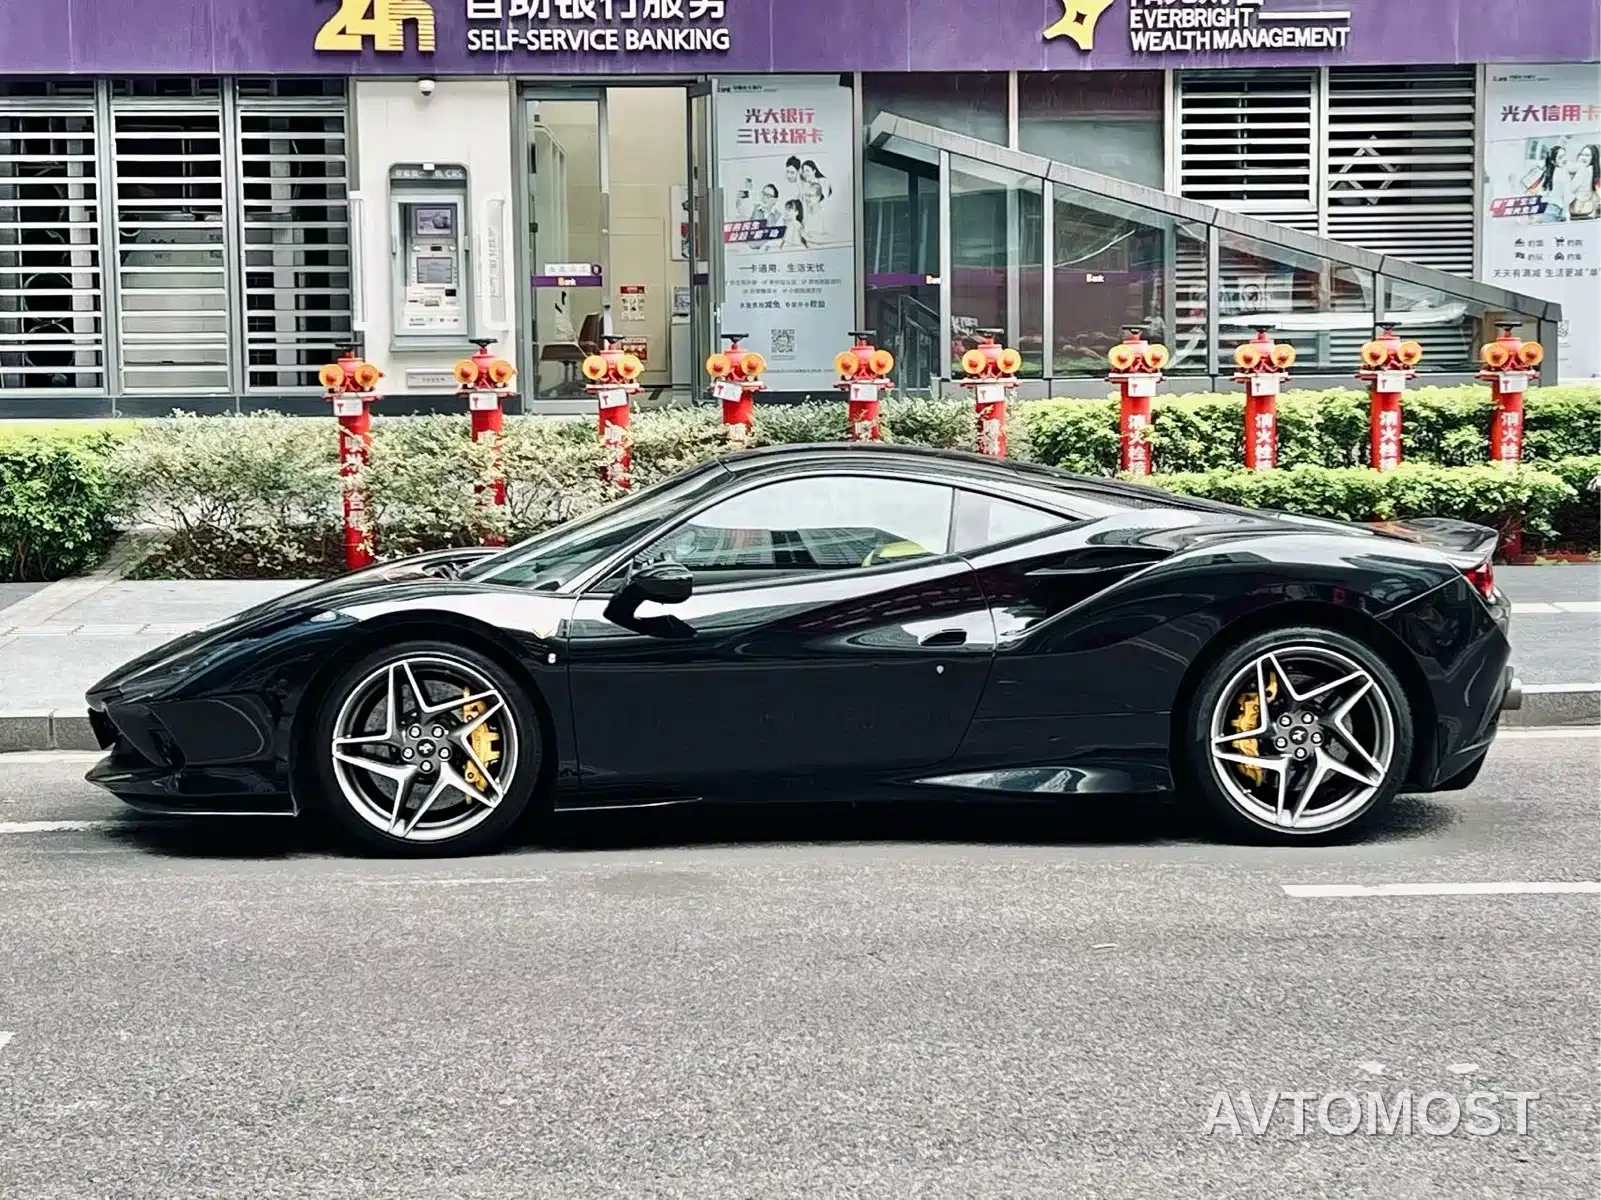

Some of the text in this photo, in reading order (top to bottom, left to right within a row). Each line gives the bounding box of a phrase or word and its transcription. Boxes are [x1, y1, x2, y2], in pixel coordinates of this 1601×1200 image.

[1129, 8, 1254, 28] EVERBRIGHT
[467, 28, 730, 51] SELF-SERVICE BANKING
[1130, 26, 1351, 51] WEALTH MANAGEMENT
[745, 108, 815, 124] 光大银行
[1500, 104, 1601, 122] 光大信用卡
[737, 128, 824, 144] 三代社保卡
[1500, 411, 1520, 463] 消火栓
